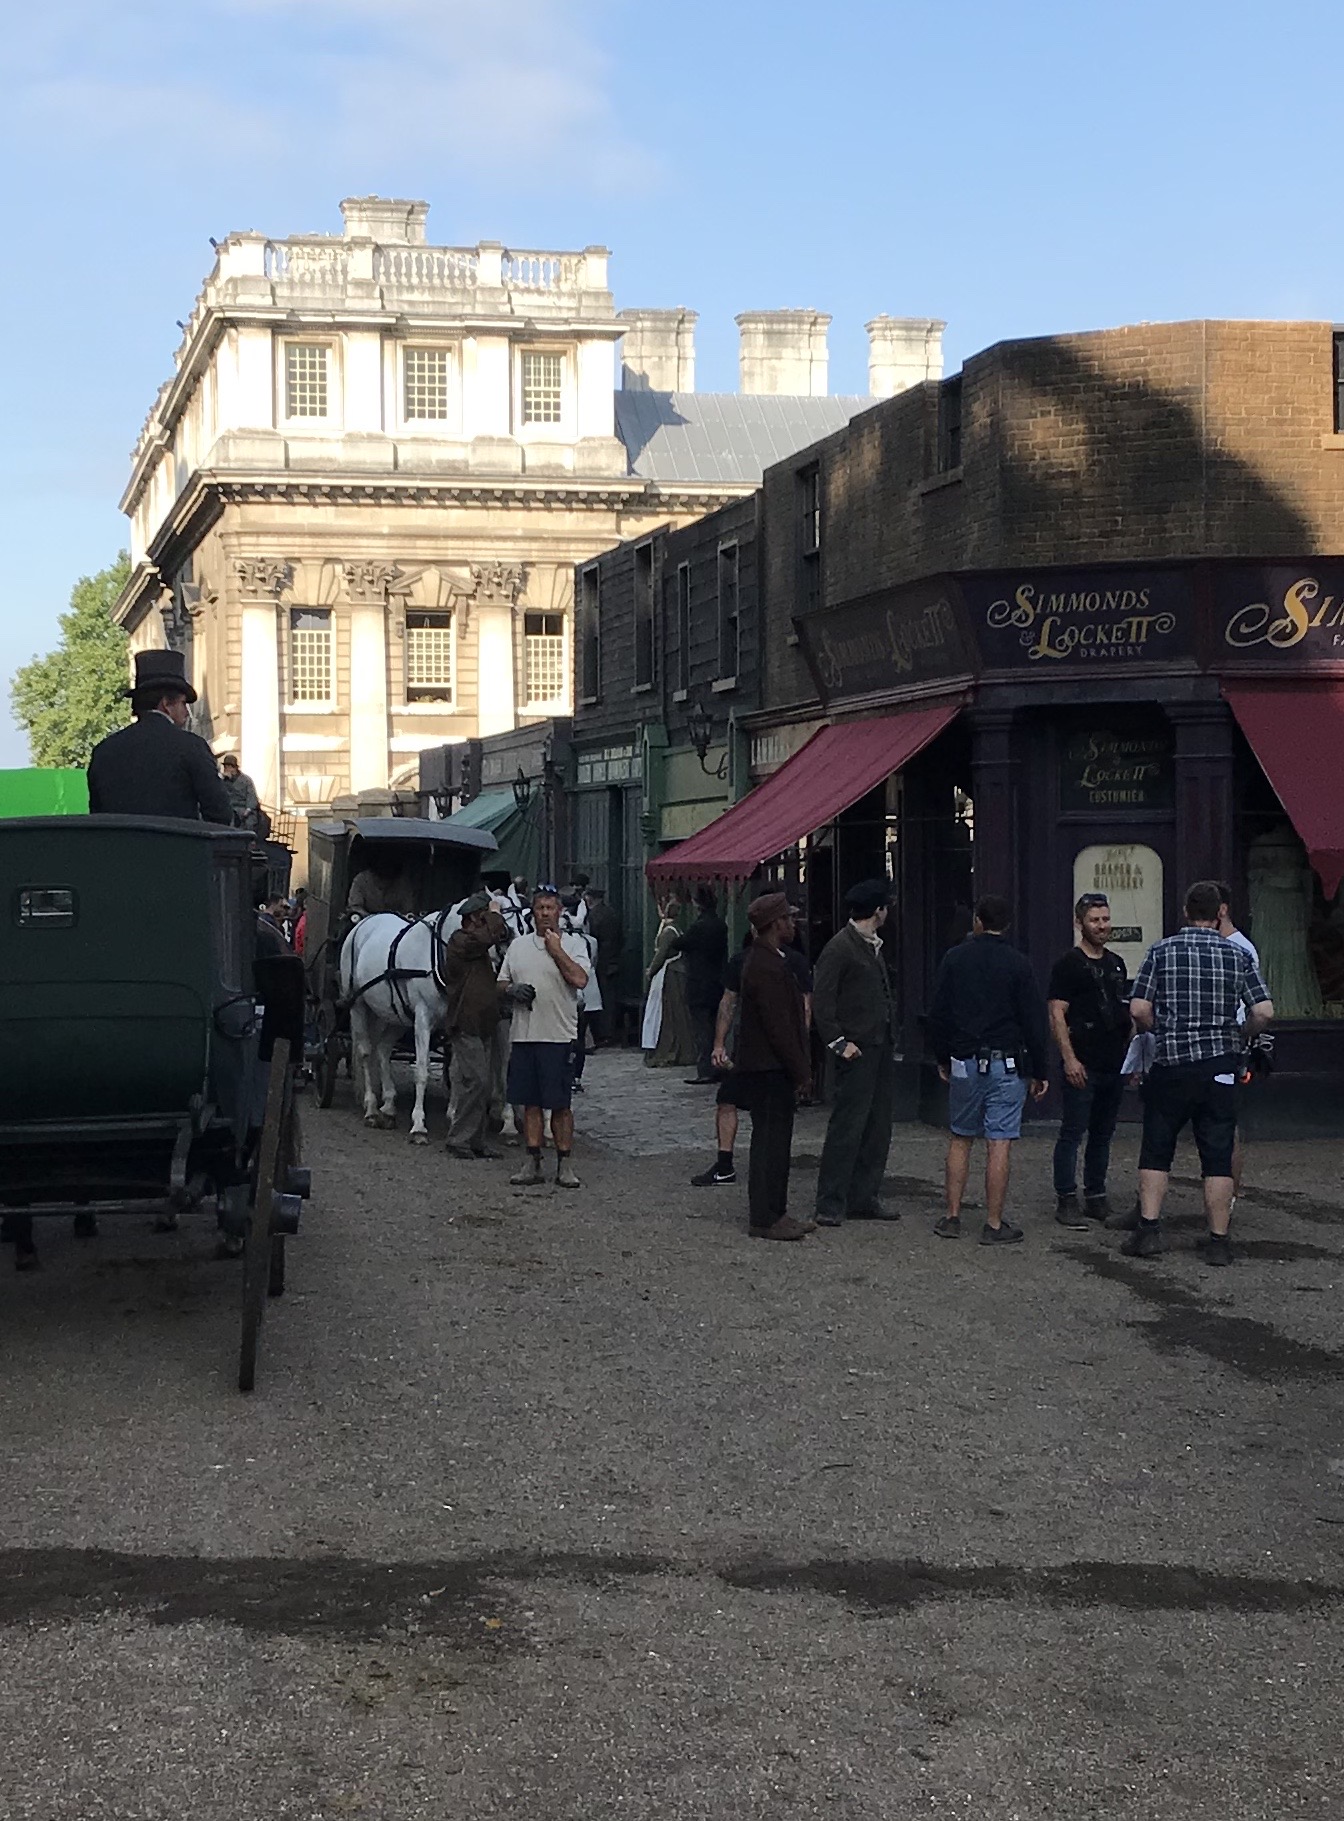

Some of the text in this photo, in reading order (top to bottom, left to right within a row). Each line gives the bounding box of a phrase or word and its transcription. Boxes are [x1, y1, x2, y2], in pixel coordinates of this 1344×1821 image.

[987, 584, 1150, 628] SIMMONDS
[886, 597, 954, 673] LOCKETT
[1019, 612, 1176, 660] & LOCKETT
[1080, 645, 1144, 658] DRAPERY
